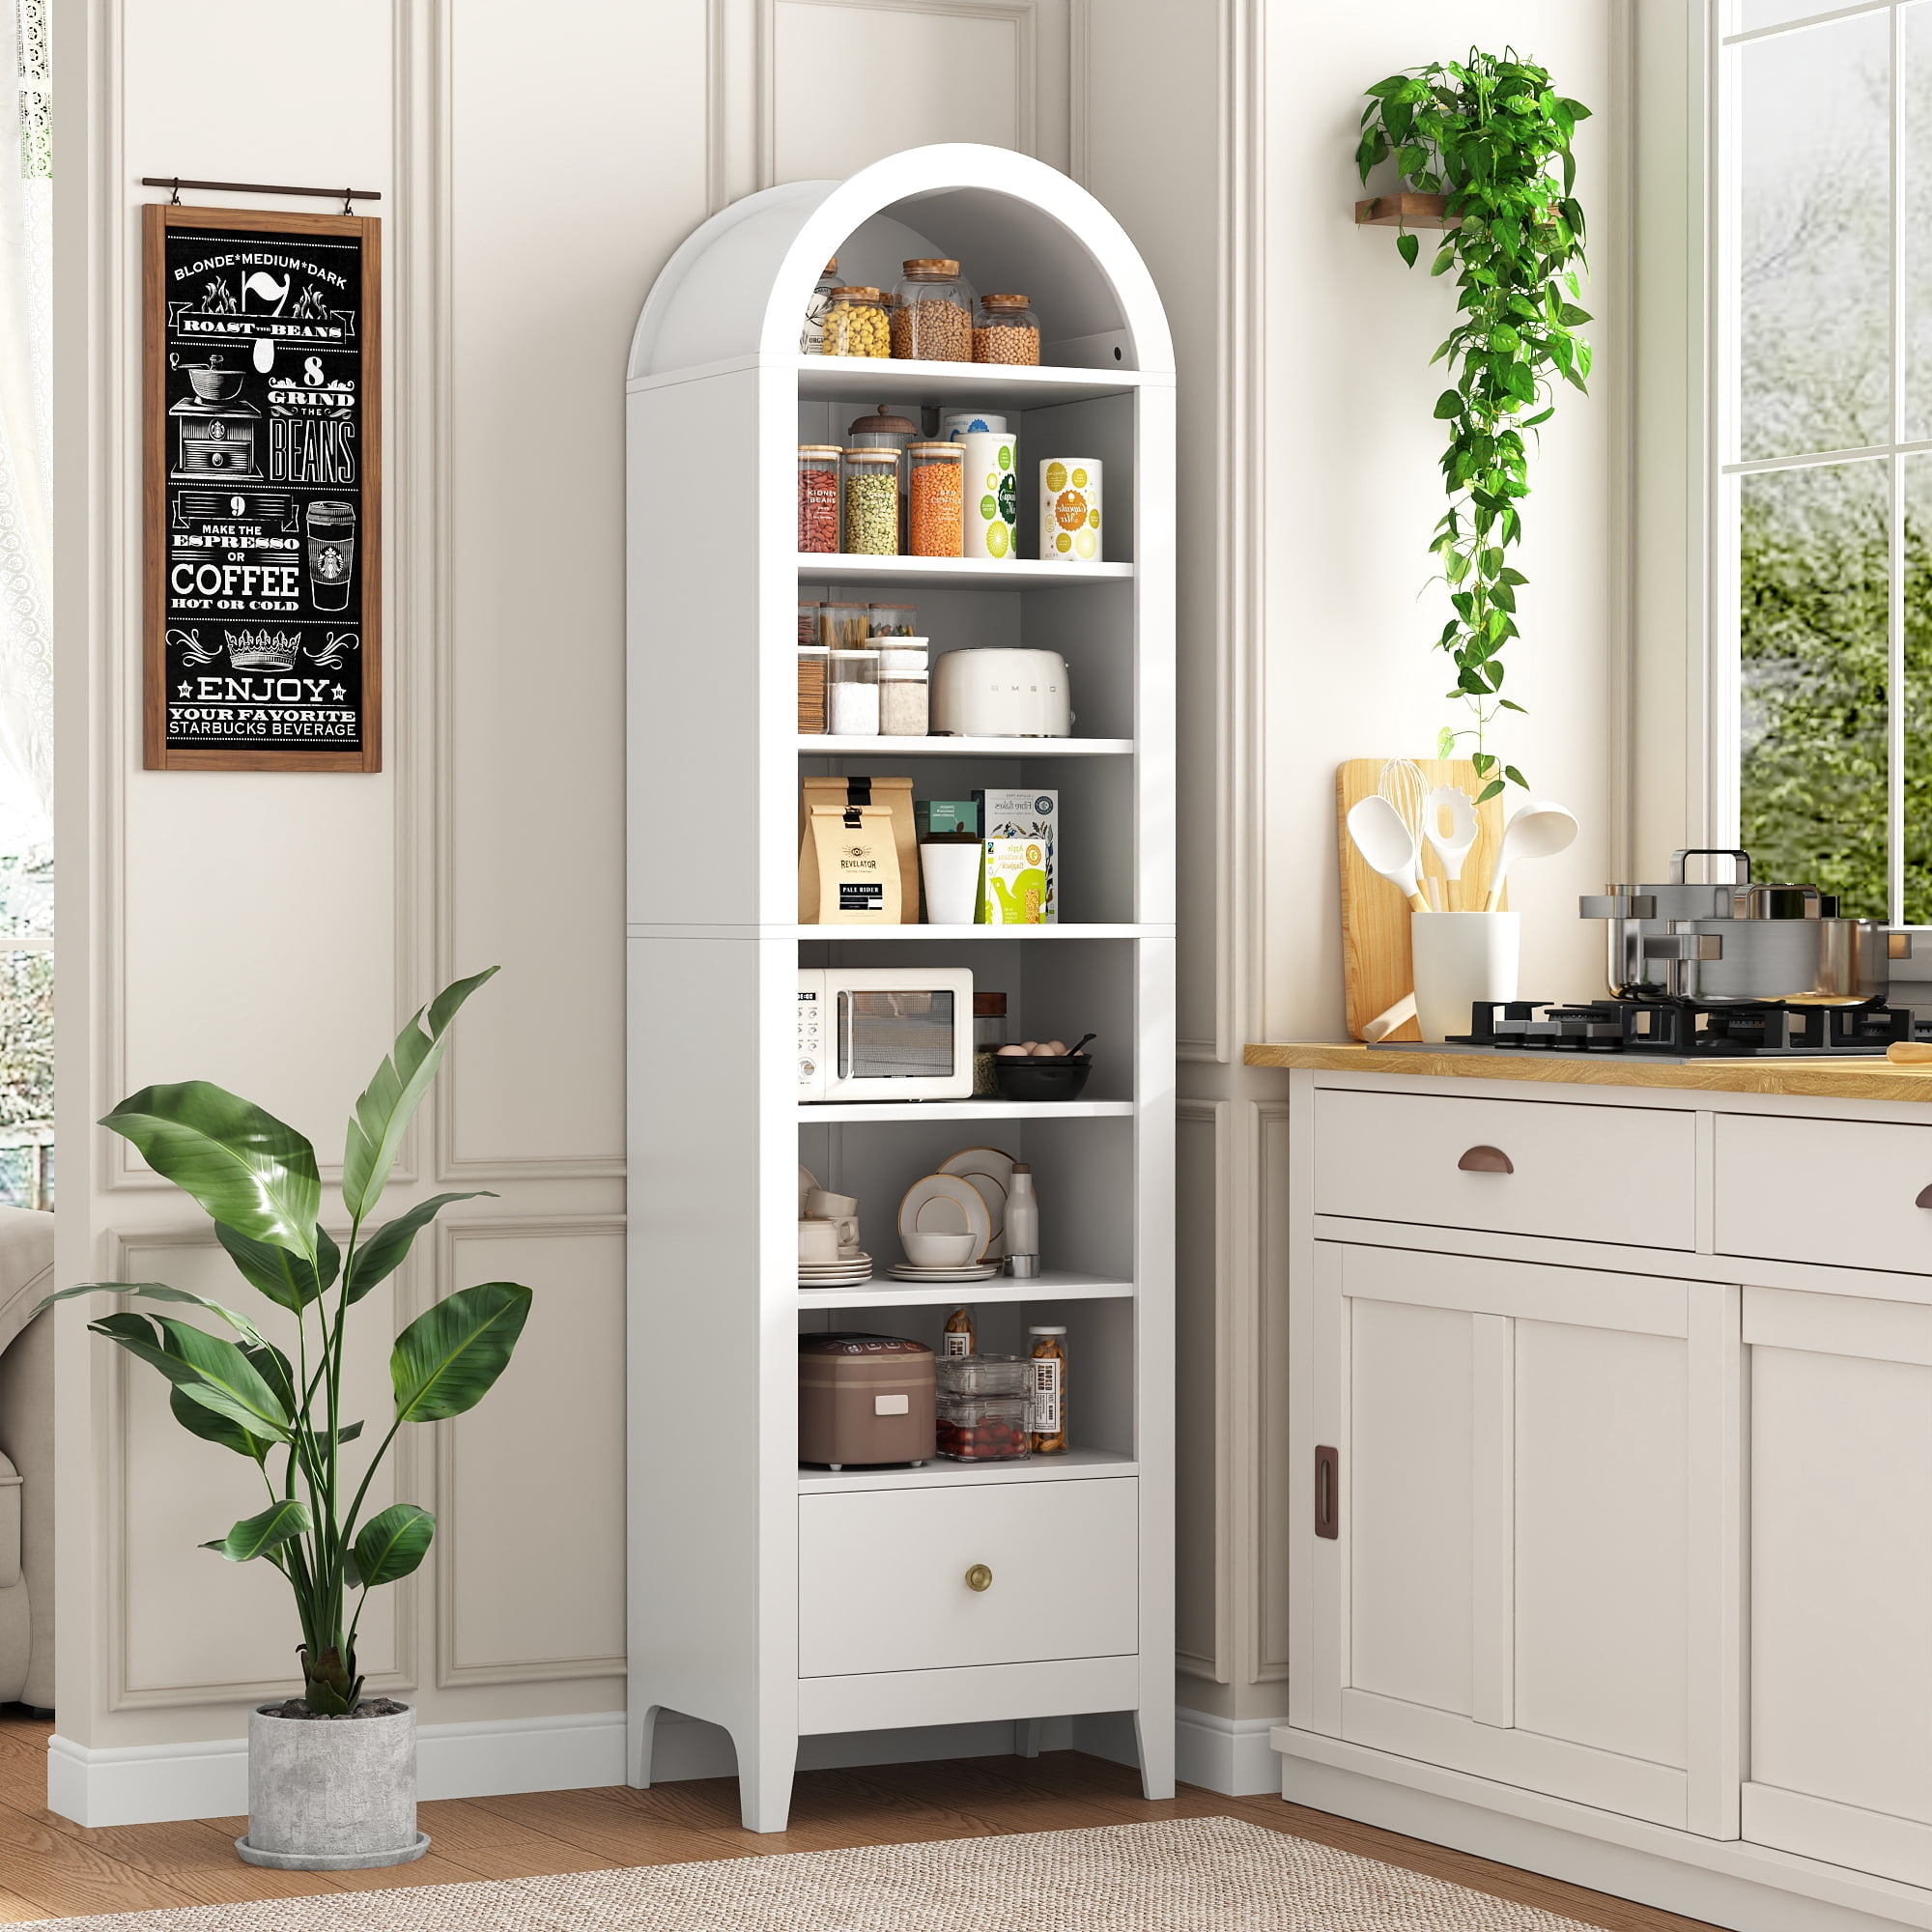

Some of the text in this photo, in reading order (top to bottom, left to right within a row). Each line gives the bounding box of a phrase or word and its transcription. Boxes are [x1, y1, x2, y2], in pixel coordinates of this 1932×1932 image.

[183, 319, 255, 335] ROAST
[270, 324, 342, 339] BEANS
[303, 355, 325, 386] 8
[267, 390, 355, 407] GRIND
[300, 408, 323, 416] THE
[269, 418, 355, 483] BEANS
[230, 496, 246, 517] 9
[202, 525, 263, 535] MAKE THE
[171, 534, 300, 551] ESPRESSO
[227, 552, 245, 562] OR
[171, 563, 300, 597] COFFEE
[170, 598, 300, 611] HOT OR COLD
[196, 677, 330, 702] ENJOY
[168, 707, 356, 724] YOUR FAVORITE
[169, 723, 356, 737] STARBUCKS BEVERAGE
[840, 860, 877, 869] REVELATOR
